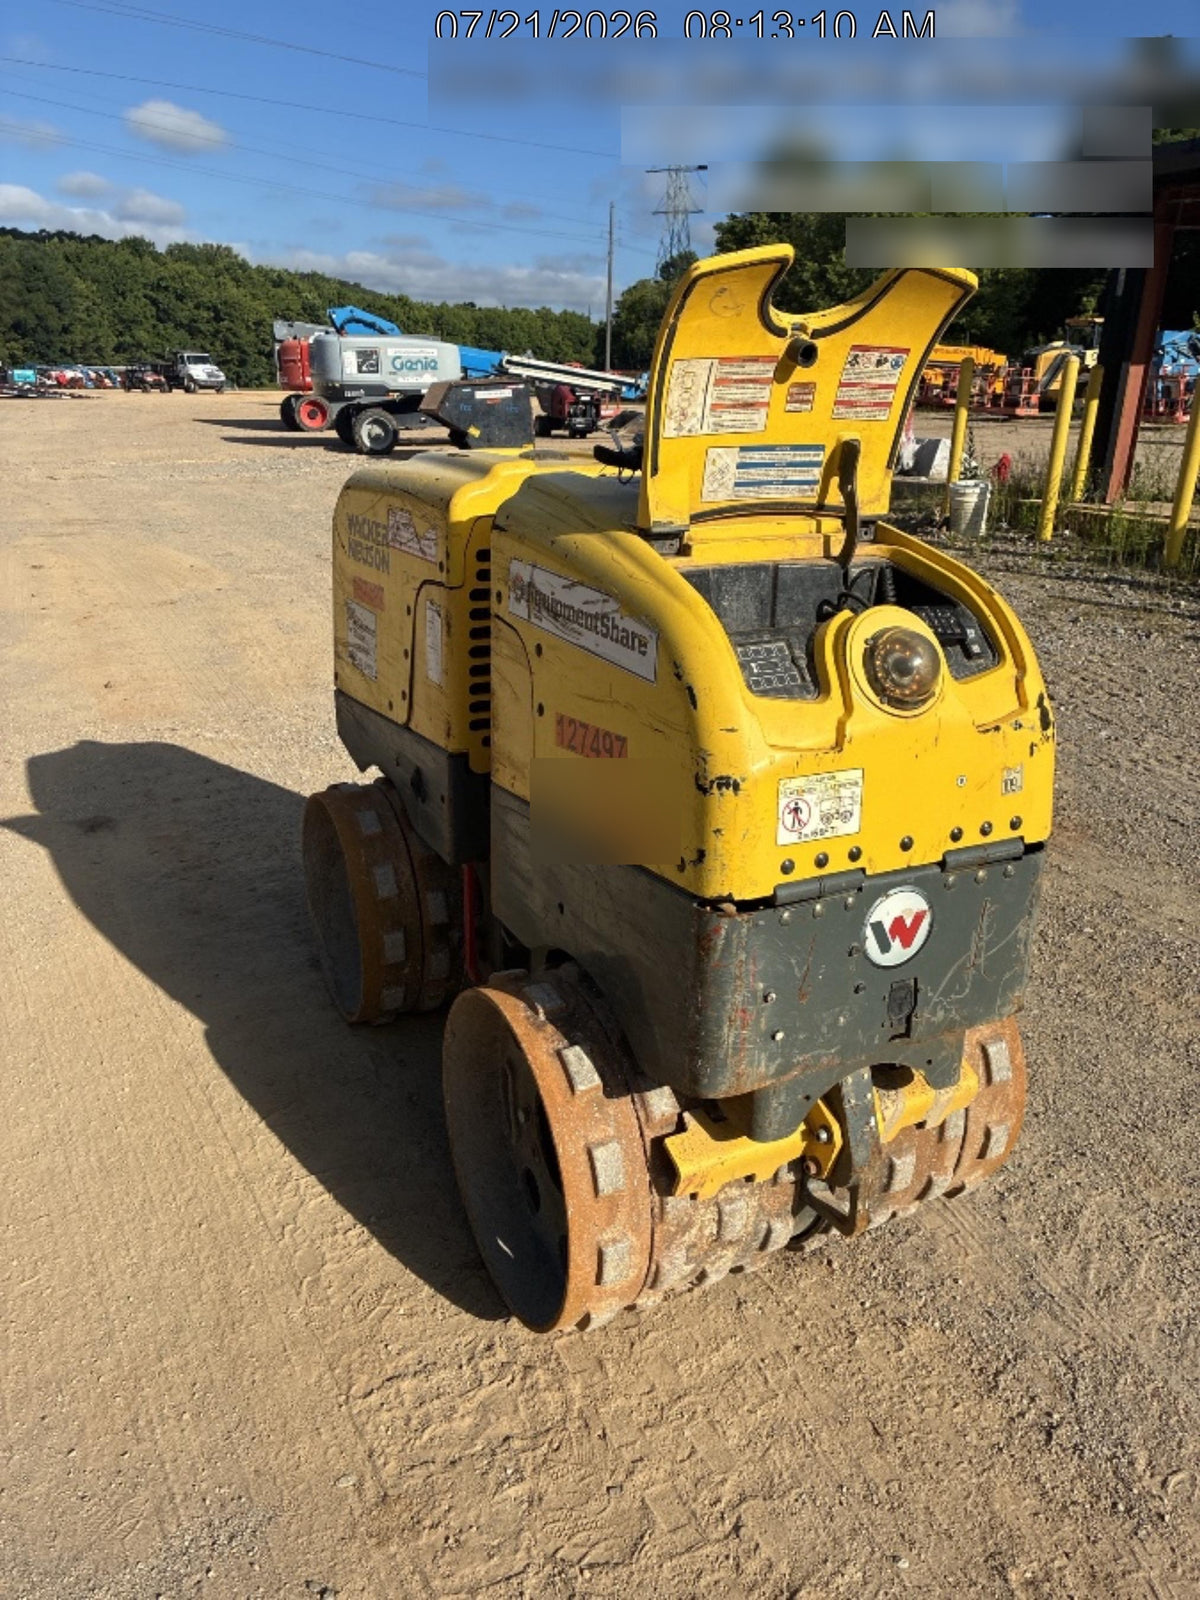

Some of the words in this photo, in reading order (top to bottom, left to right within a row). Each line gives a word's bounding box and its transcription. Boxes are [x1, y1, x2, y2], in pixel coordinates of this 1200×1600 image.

[391, 356, 438, 371] Genie
[347, 512, 389, 545] WACKER
[348, 537, 390, 575] NEUSON
[556, 714, 628, 758] 127497
